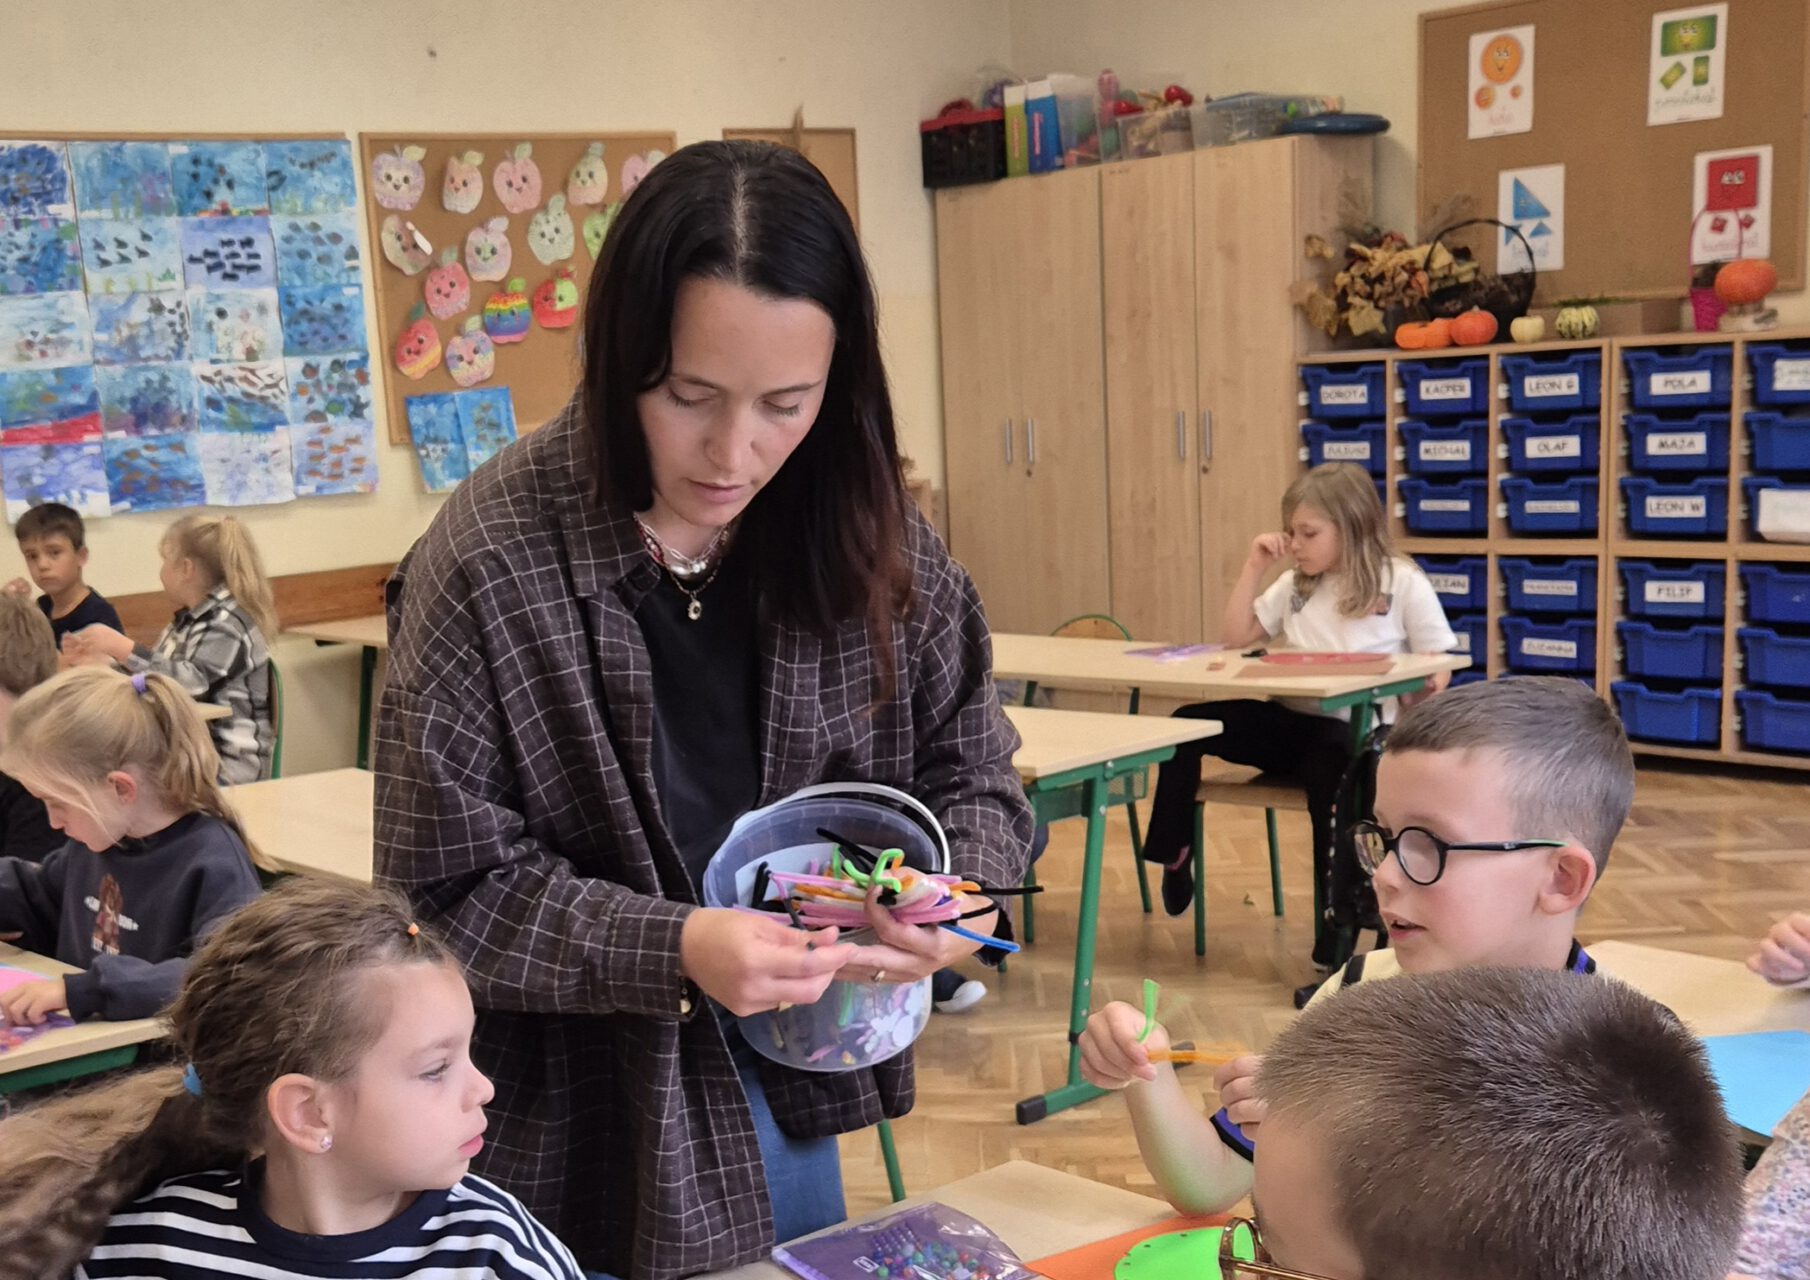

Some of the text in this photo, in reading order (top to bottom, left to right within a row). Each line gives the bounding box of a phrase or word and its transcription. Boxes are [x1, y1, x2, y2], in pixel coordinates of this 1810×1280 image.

[1424, 383, 1466, 395] KACPER
[1528, 379, 1562, 393] LEON
[1663, 376, 1698, 389] POLA
[1536, 441, 1570, 453] OLAF
[1649, 501, 1702, 514] LEON W
[1656, 584, 1694, 598] FILIP
